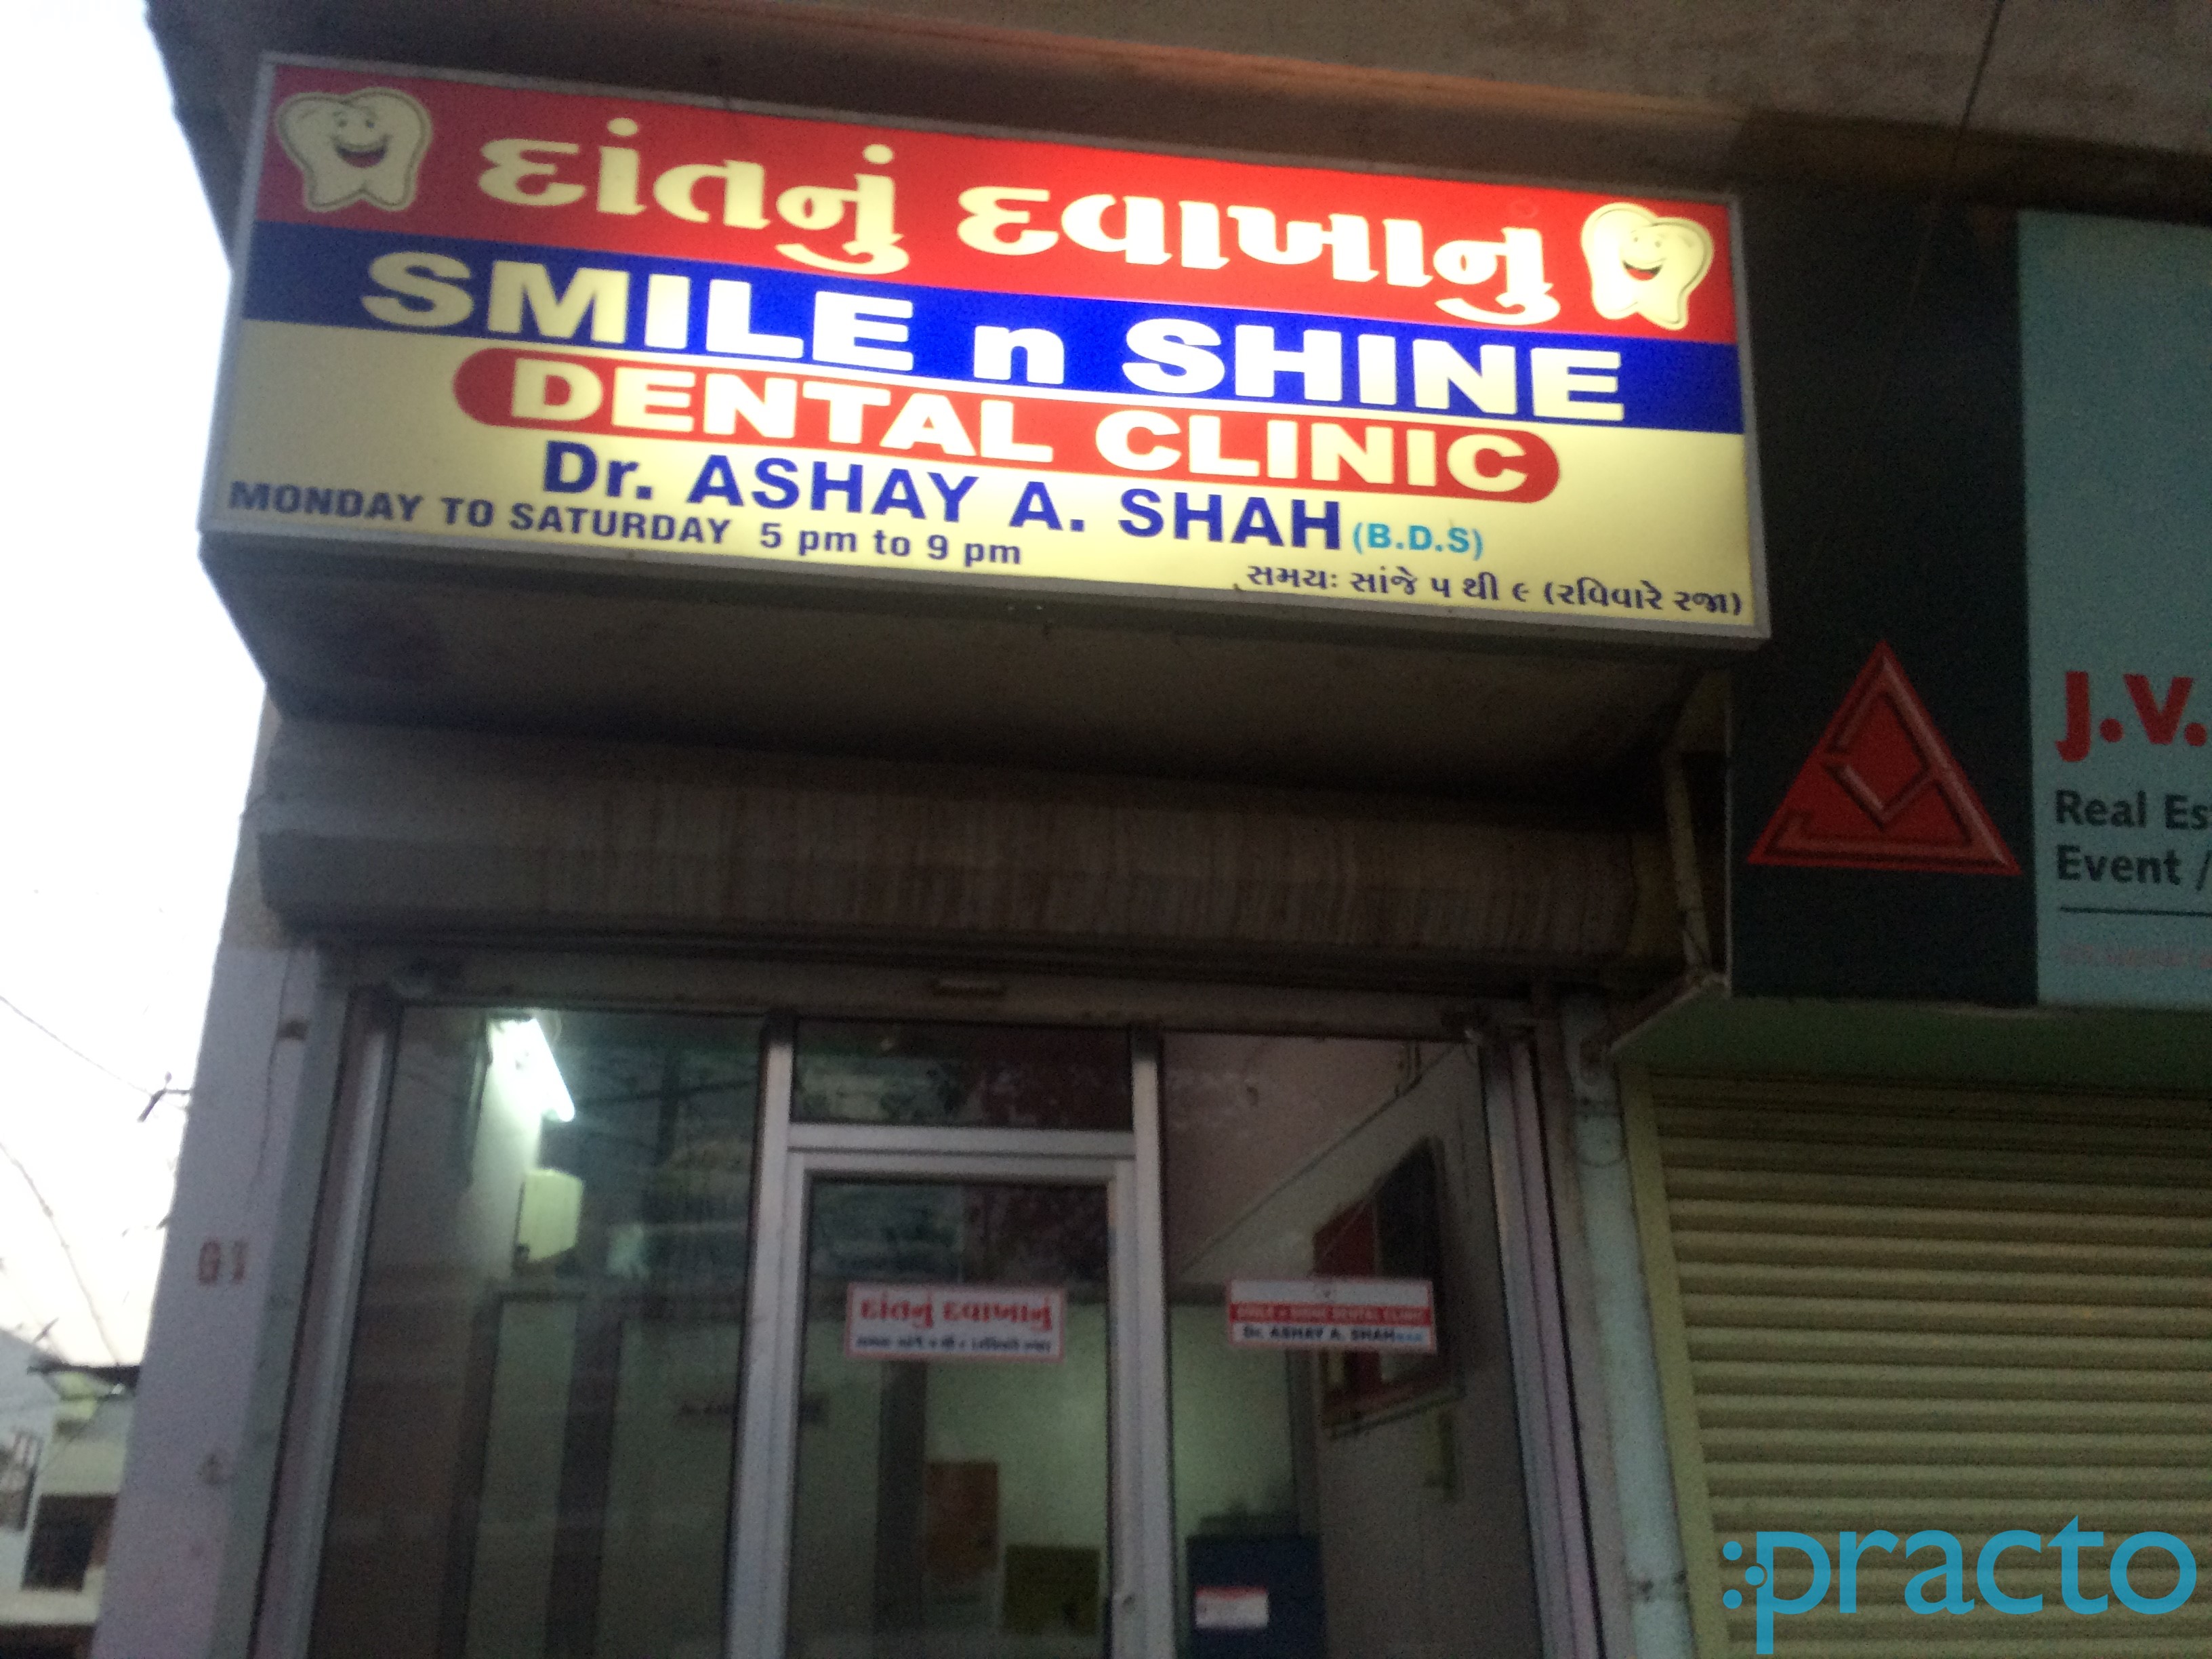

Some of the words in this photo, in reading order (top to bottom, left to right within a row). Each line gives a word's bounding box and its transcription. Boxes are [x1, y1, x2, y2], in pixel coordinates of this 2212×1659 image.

[478, 117, 909, 274] દાંતનું
[361, 251, 914, 371] SMILE
[973, 325, 1064, 384] n
[1122, 318, 1624, 421] SHINE
[510, 358, 1053, 462] DENTAL
[1096, 410, 1531, 493] CLINIC
[228, 480, 423, 522] MONDAY
[441, 496, 493, 528] TO
[509, 503, 731, 544] SATURDAY
[760, 523, 781, 548] 5
[798, 529, 857, 556] pm
[873, 529, 911, 557] to
[927, 535, 948, 560] 9
[965, 539, 1021, 567] pm
[542, 440, 652, 499] Dr.
[686, 455, 979, 522] ASHAY
[1008, 481, 1084, 531] A.
[1118, 488, 1341, 550] SHAH
[1352, 522, 1484, 560] (B.D.S)
[1349, 566, 1416, 596] સાંજે
[1462, 572, 1499, 601] થી
[2054, 670, 2207, 762] J.V.
[2055, 790, 2147, 829] Real
[2165, 794, 2212, 830] Es
[2056, 844, 2182, 886] Event
